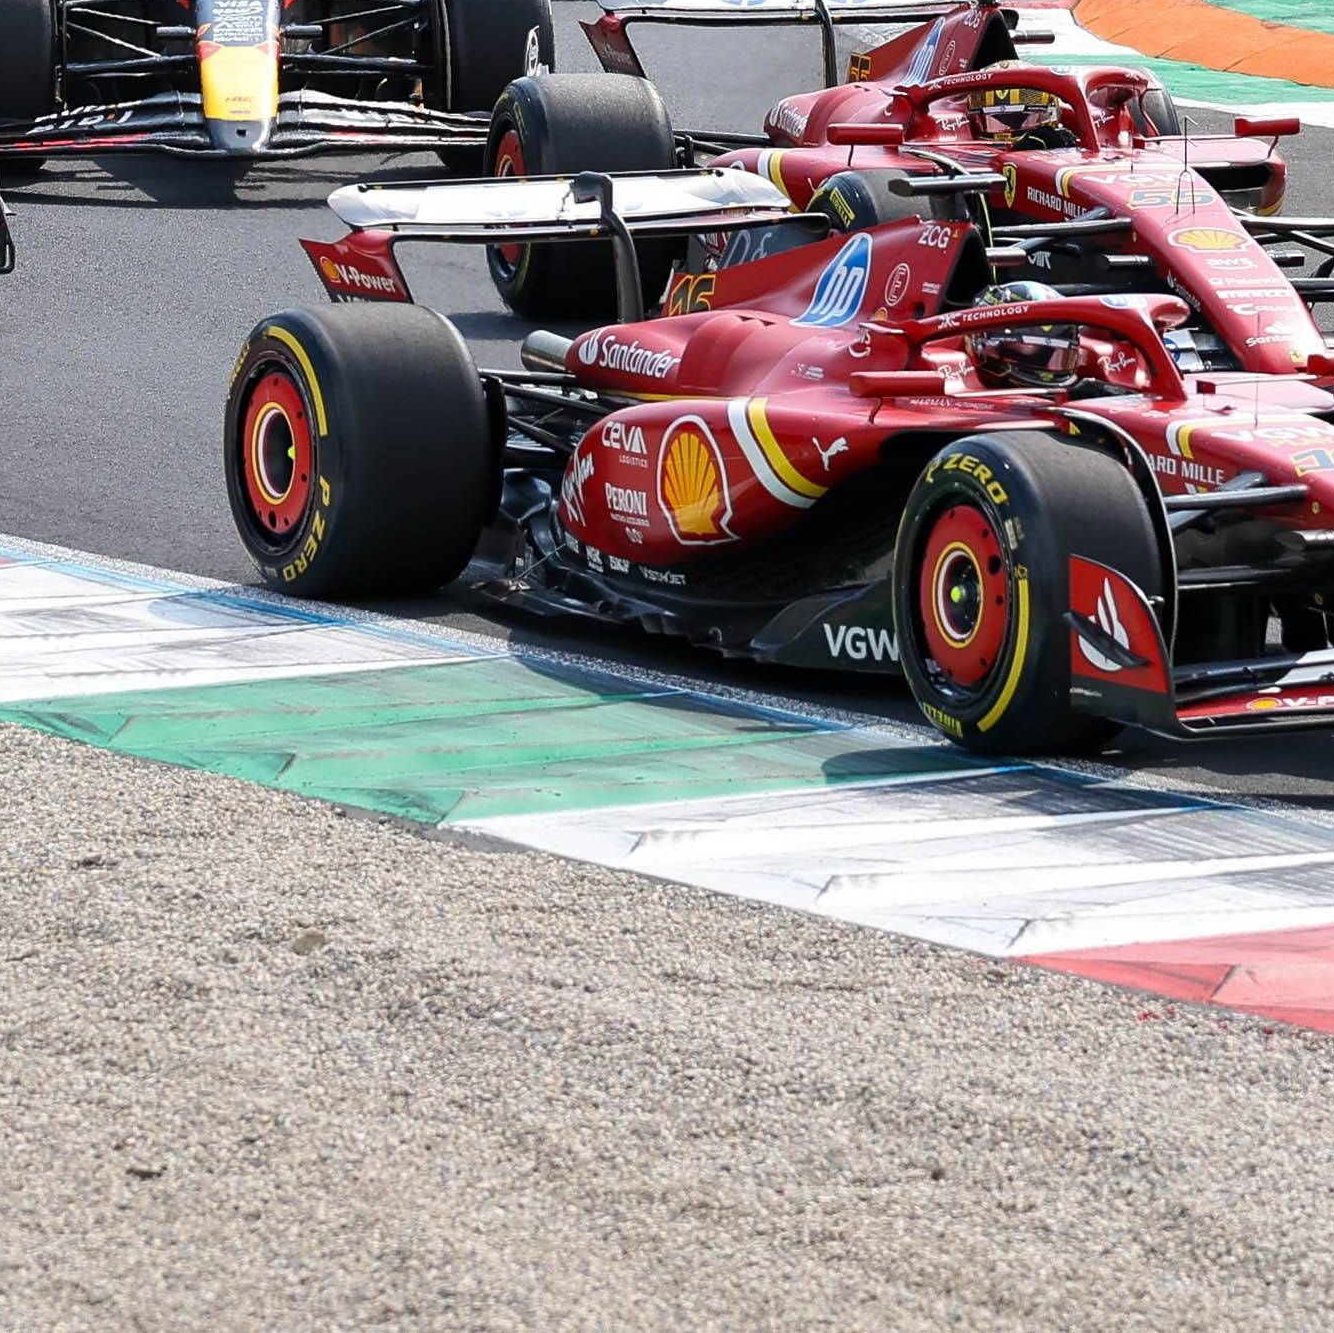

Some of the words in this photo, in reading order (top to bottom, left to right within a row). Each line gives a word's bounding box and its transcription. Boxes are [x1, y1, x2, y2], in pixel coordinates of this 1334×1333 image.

[944, 72, 994, 84] TECHNOLOGY
[1027, 186, 1062, 212] RICHARD
[1128, 188, 1216, 211] 55
[918, 224, 952, 249] ZCG
[337, 263, 397, 294] V-Power
[668, 272, 717, 316] 16
[811, 235, 865, 326] hp
[962, 304, 1030, 322] TECHNOLOGY
[602, 333, 682, 379] Santander
[619, 454, 648, 468] LOGISTICS
[1181, 462, 1225, 486] MILLE
[319, 474, 331, 507] P
[943, 452, 1009, 505] ZERO
[604, 482, 648, 517] PERONI
[282, 509, 327, 583] ZERO
[823, 623, 900, 662] VGW
